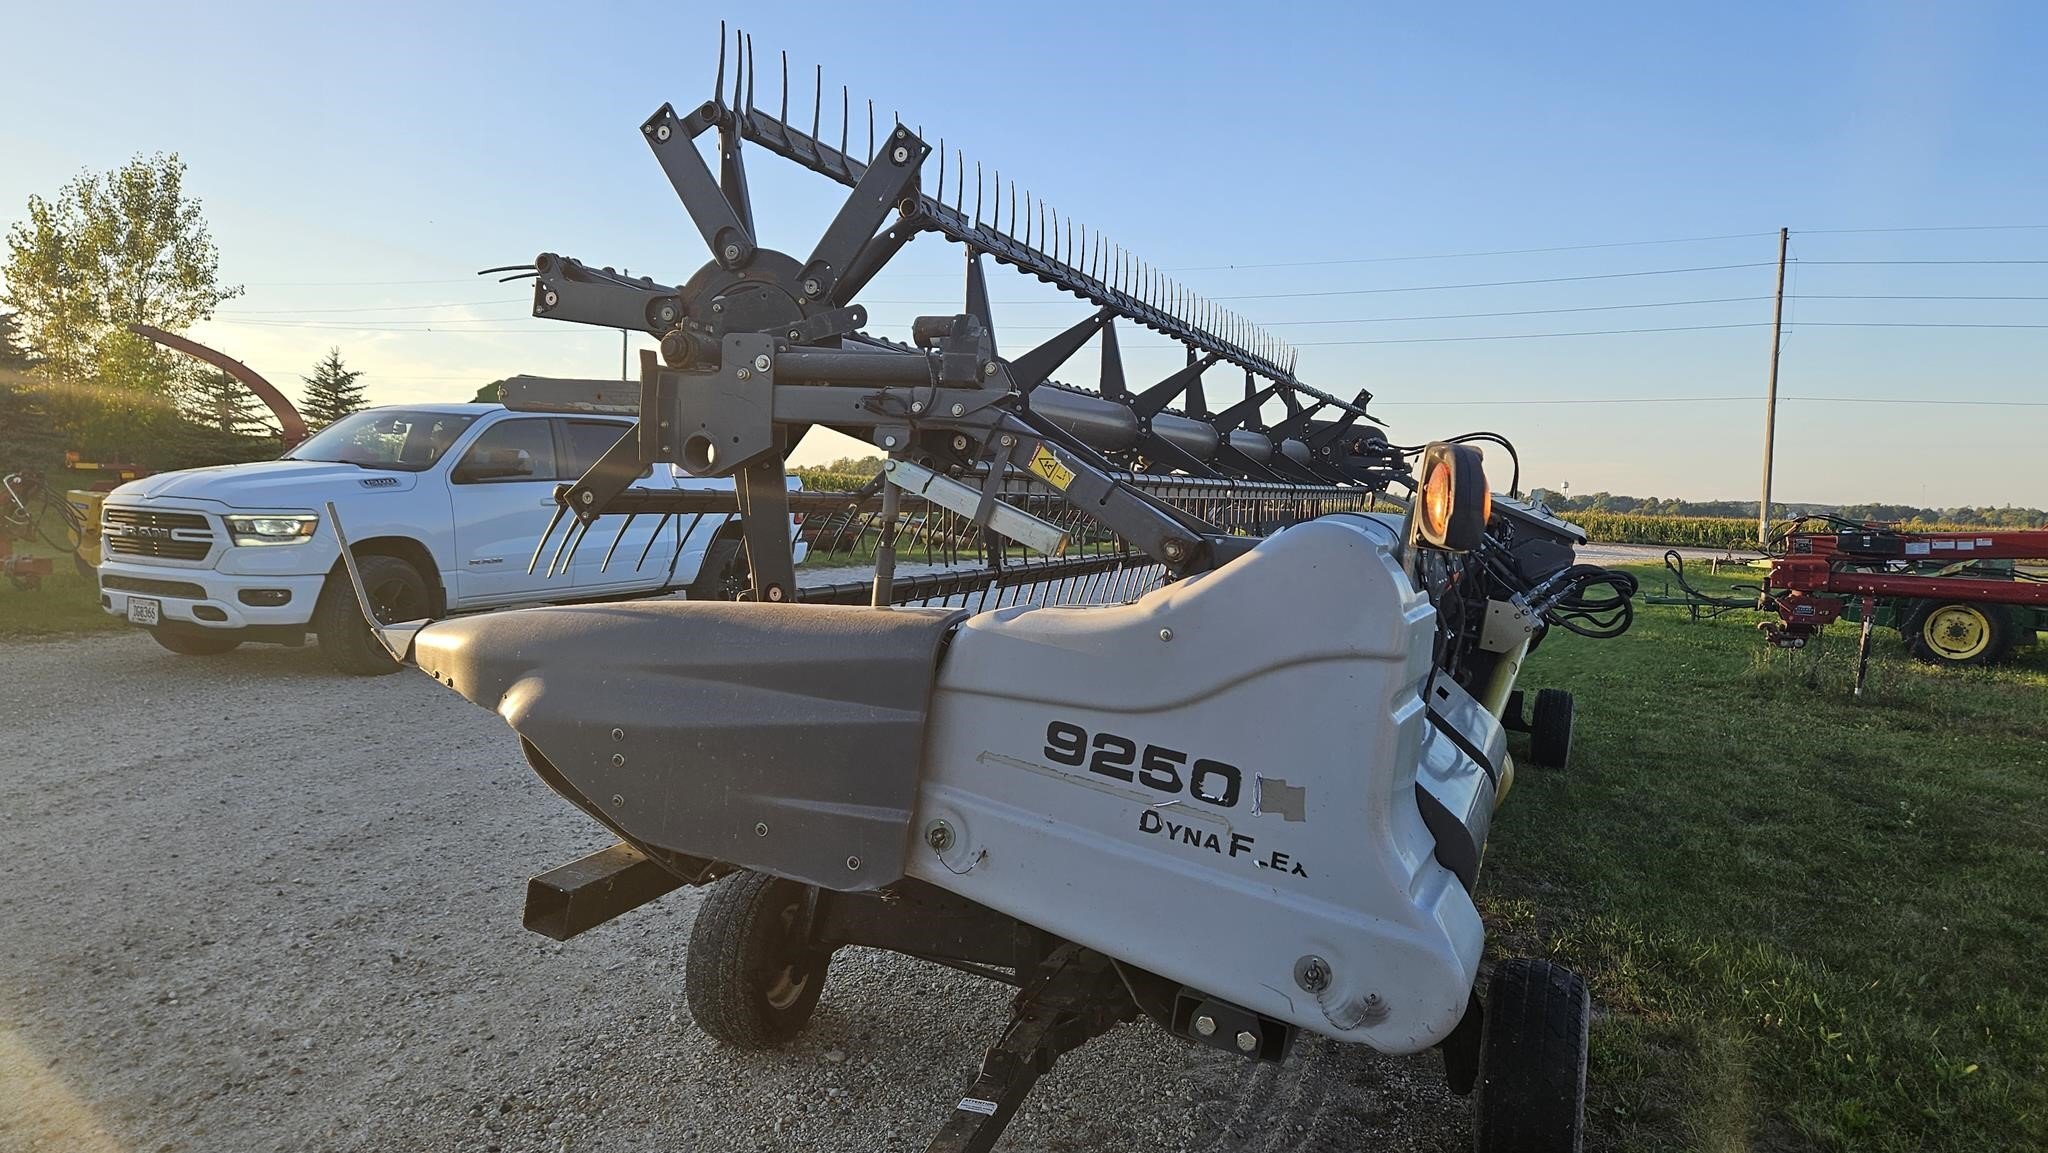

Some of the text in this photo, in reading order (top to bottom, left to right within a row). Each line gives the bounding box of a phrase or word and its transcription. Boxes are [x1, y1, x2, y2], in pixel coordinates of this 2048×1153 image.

[121, 525, 169, 539] RAM
[468, 557, 504, 566] RAM
[1044, 720, 1242, 808] 9250
